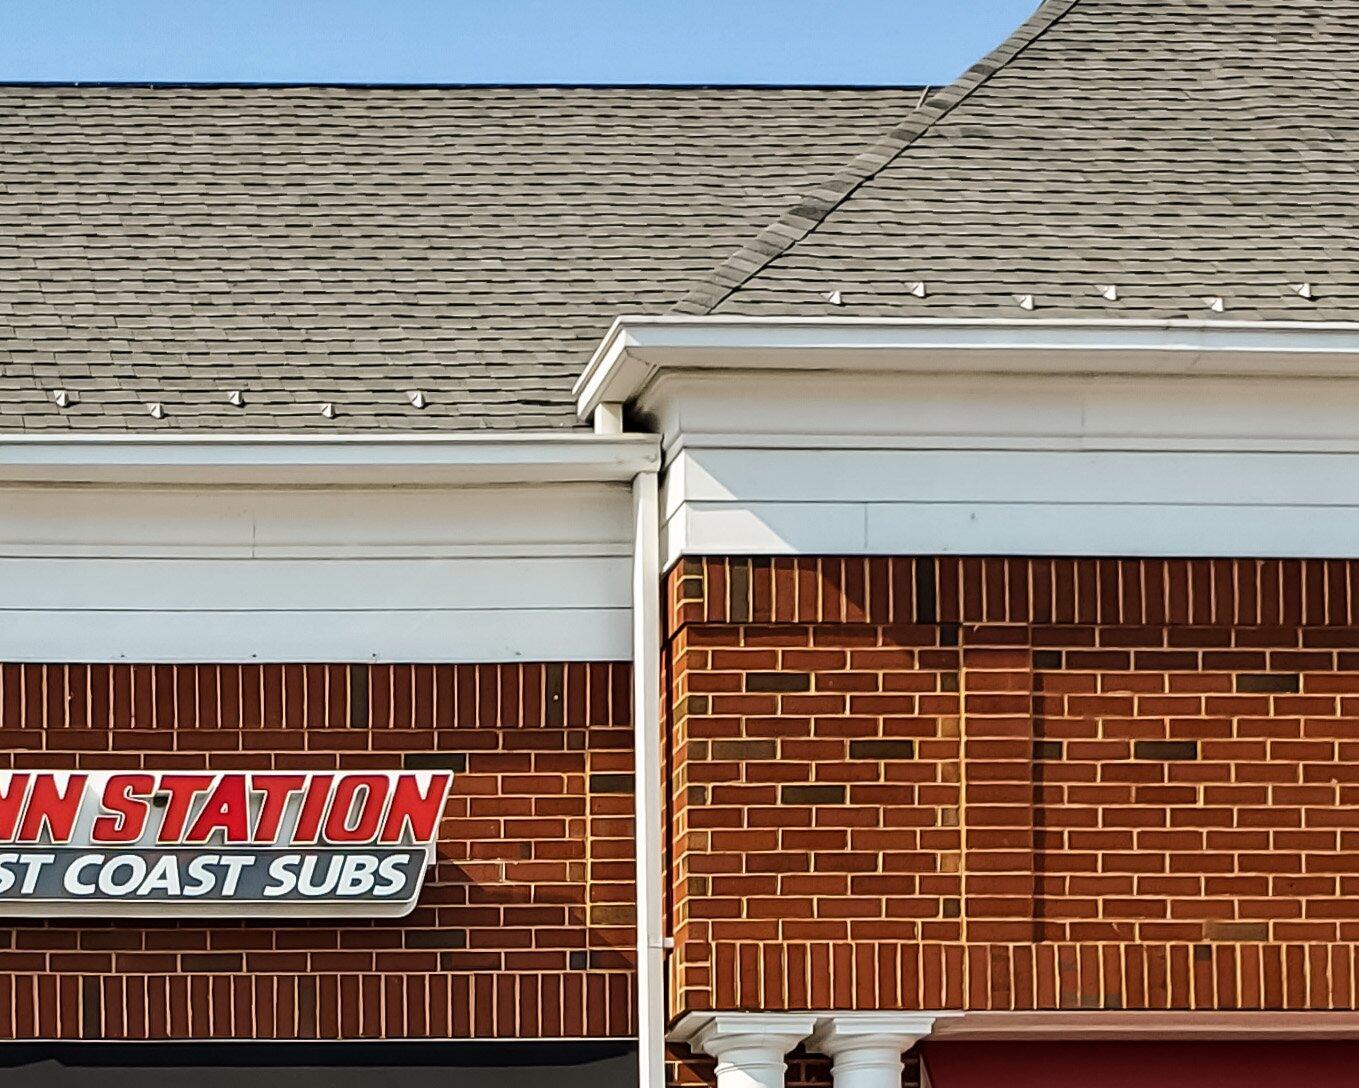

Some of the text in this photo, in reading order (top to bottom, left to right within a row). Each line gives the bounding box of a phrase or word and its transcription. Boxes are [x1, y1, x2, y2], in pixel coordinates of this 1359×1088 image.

[92, 773, 452, 844] STATION
[63, 854, 256, 896] COAST
[263, 854, 410, 897] SUBS
